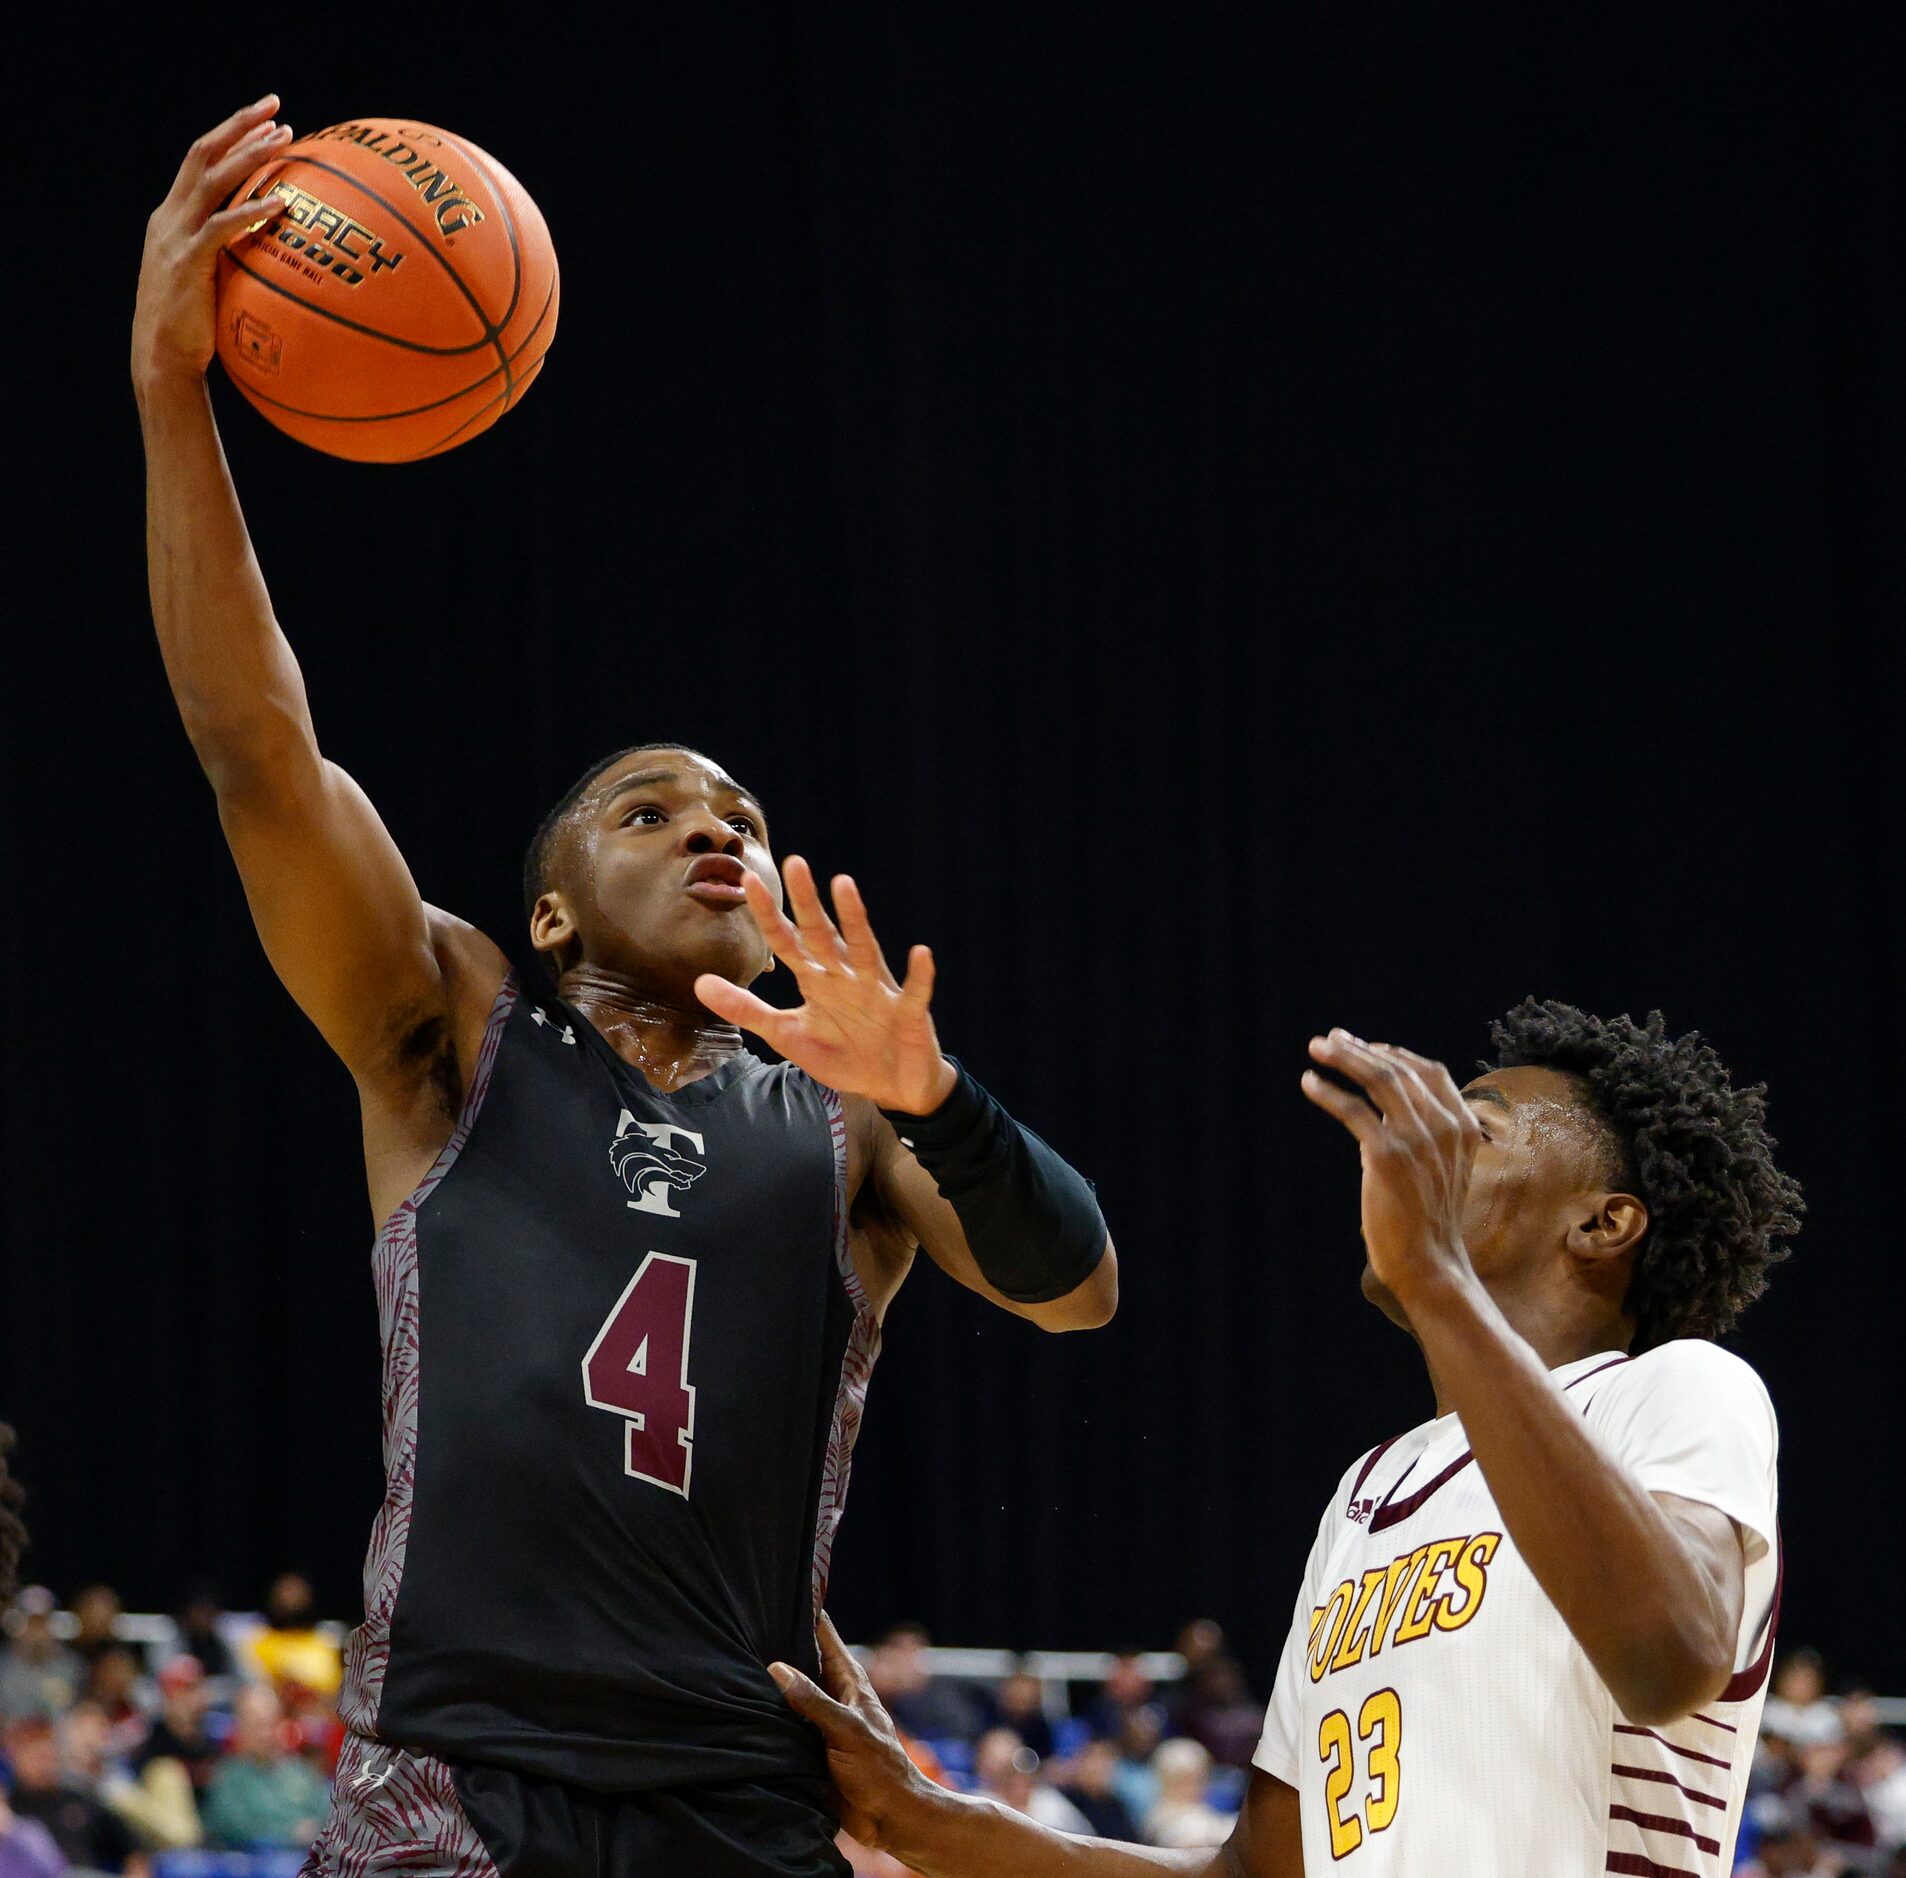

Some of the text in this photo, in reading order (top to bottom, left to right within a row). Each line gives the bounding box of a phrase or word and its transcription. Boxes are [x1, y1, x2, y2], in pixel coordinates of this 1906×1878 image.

[294, 124, 486, 238] PALDING
[280, 251, 302, 271] GAME
[302, 266, 324, 285] BALL
[581, 1250, 698, 1501] 4
[1318, 1686, 1402, 1861] 23
